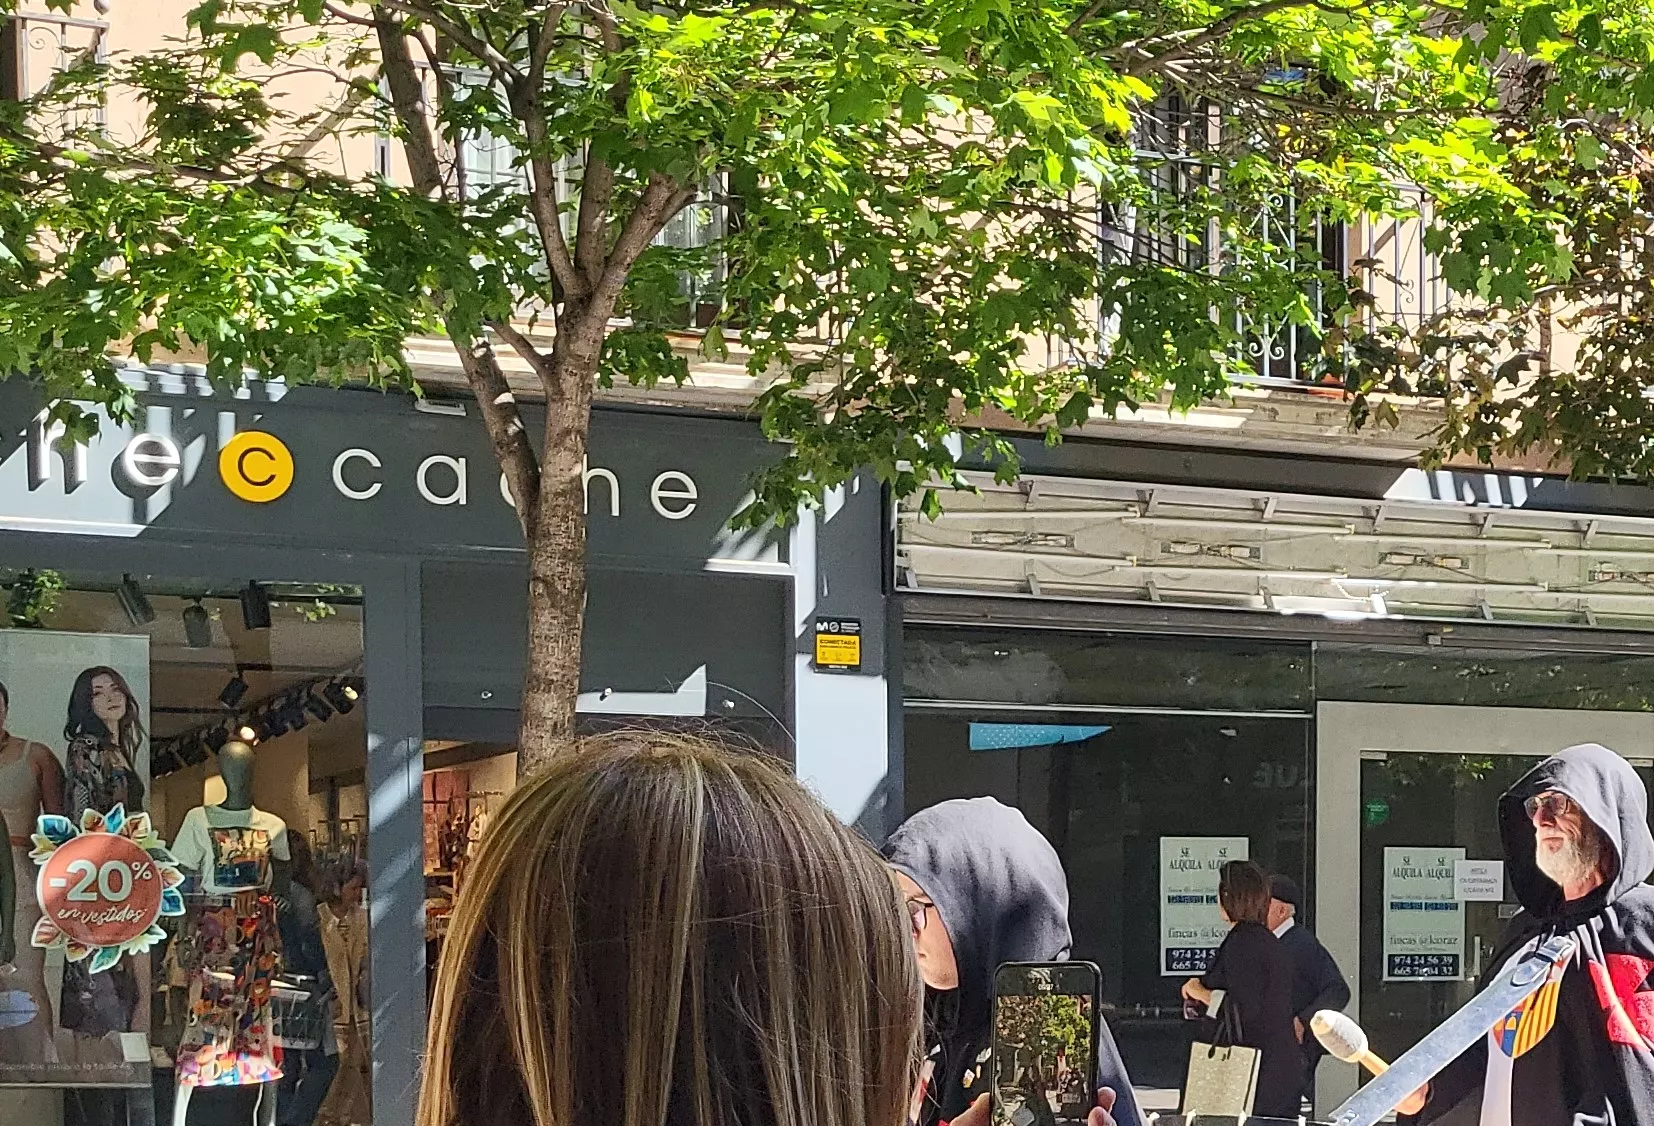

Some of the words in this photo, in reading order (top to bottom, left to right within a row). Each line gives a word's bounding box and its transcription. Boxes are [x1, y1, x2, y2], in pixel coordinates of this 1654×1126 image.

[1169, 859, 1203, 872] ALQUILA
[1392, 867, 1423, 880] ALQUILA
[49, 859, 153, 902] -20%
[57, 907, 81, 920] en
[80, 904, 147, 926] vestidos
[1172, 949, 1191, 959] 974
[1194, 949, 1206, 959] 24
[1394, 955, 1411, 965] 974
[1427, 955, 1439, 965] 56
[1172, 961, 1191, 970] 665
